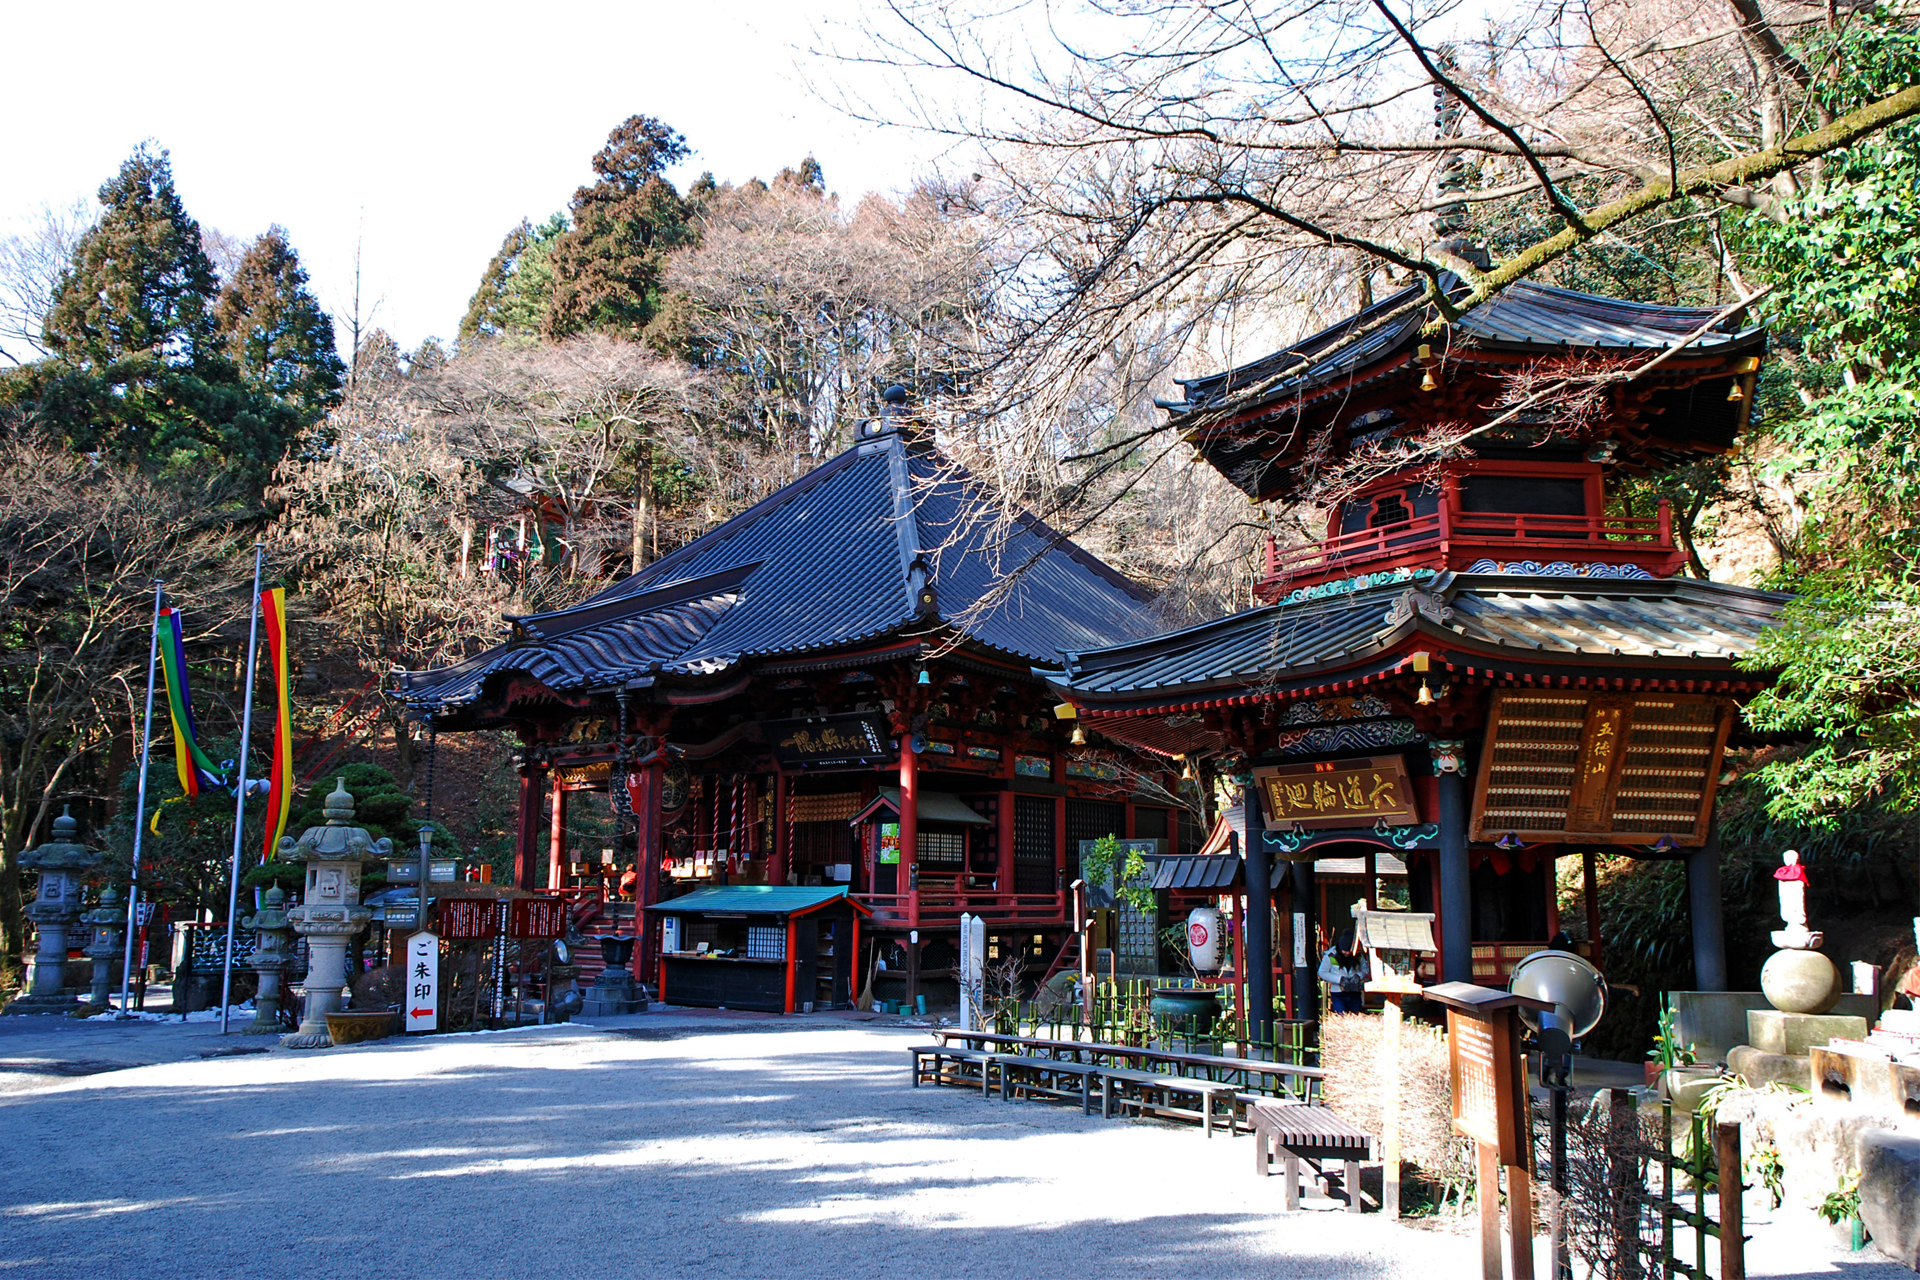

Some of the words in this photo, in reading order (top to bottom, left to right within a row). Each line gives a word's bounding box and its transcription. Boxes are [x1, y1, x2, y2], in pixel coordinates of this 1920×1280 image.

[1591, 721, 1614, 774] 五徳山
[413, 940, 432, 1001] ご朱印
